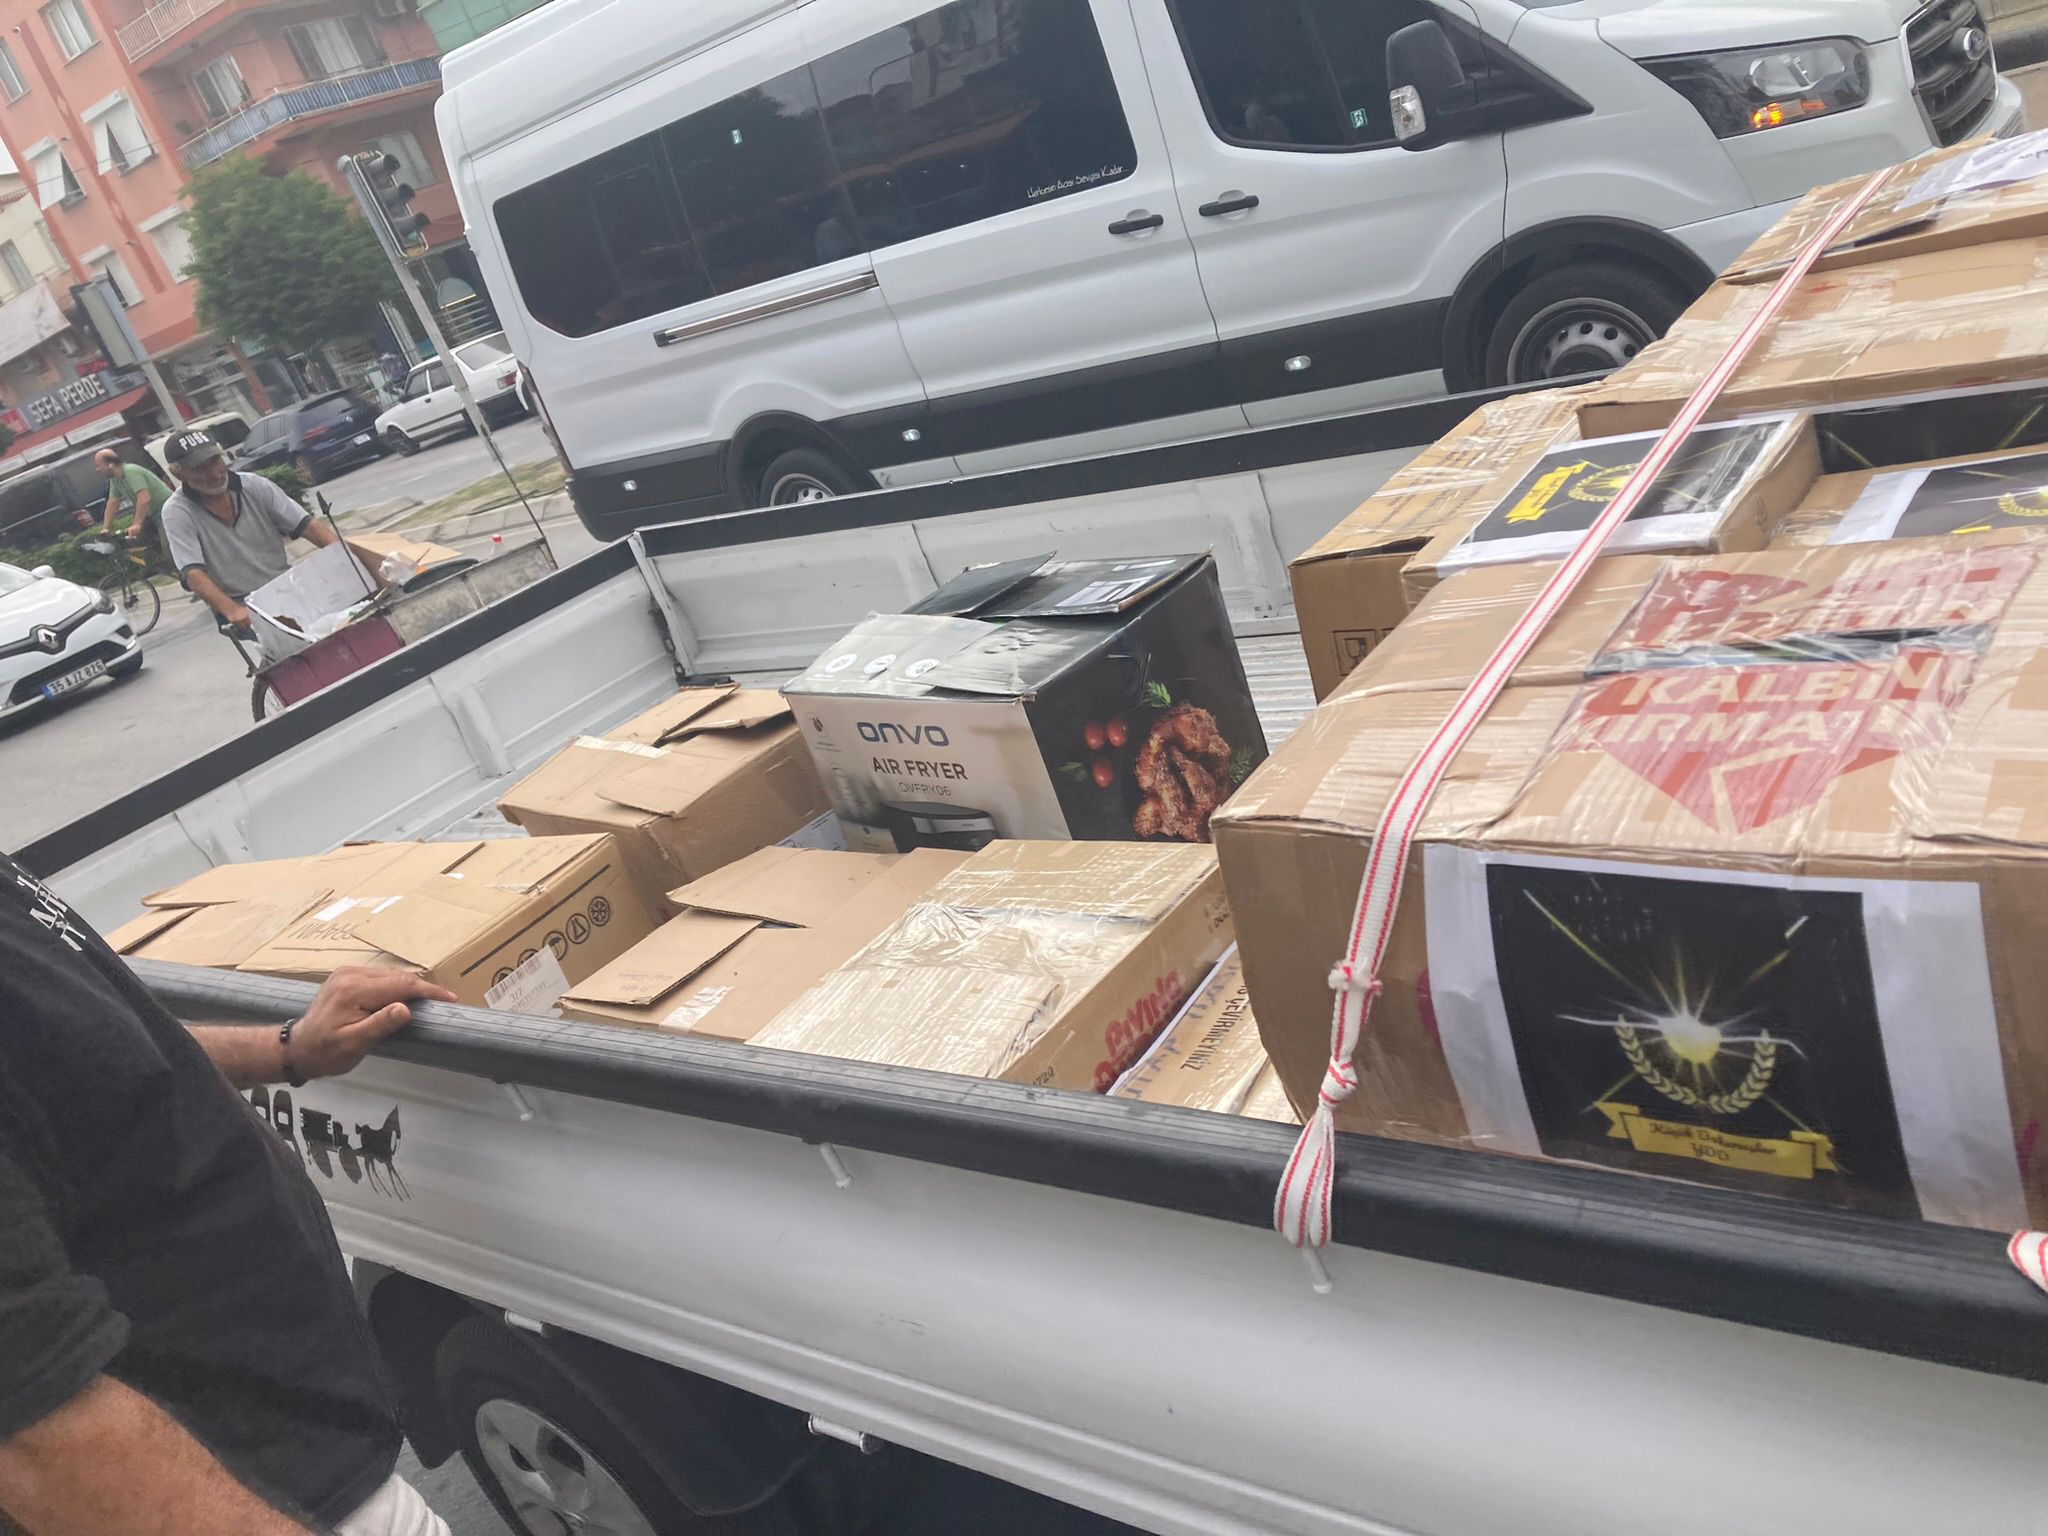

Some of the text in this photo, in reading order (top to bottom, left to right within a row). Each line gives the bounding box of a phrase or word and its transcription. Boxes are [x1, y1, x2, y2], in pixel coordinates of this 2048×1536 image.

[28, 393, 64, 423] SEFA
[59, 373, 106, 409] PERDE
[49, 681, 65, 695] 35
[872, 756, 969, 781] AIR FRYER
